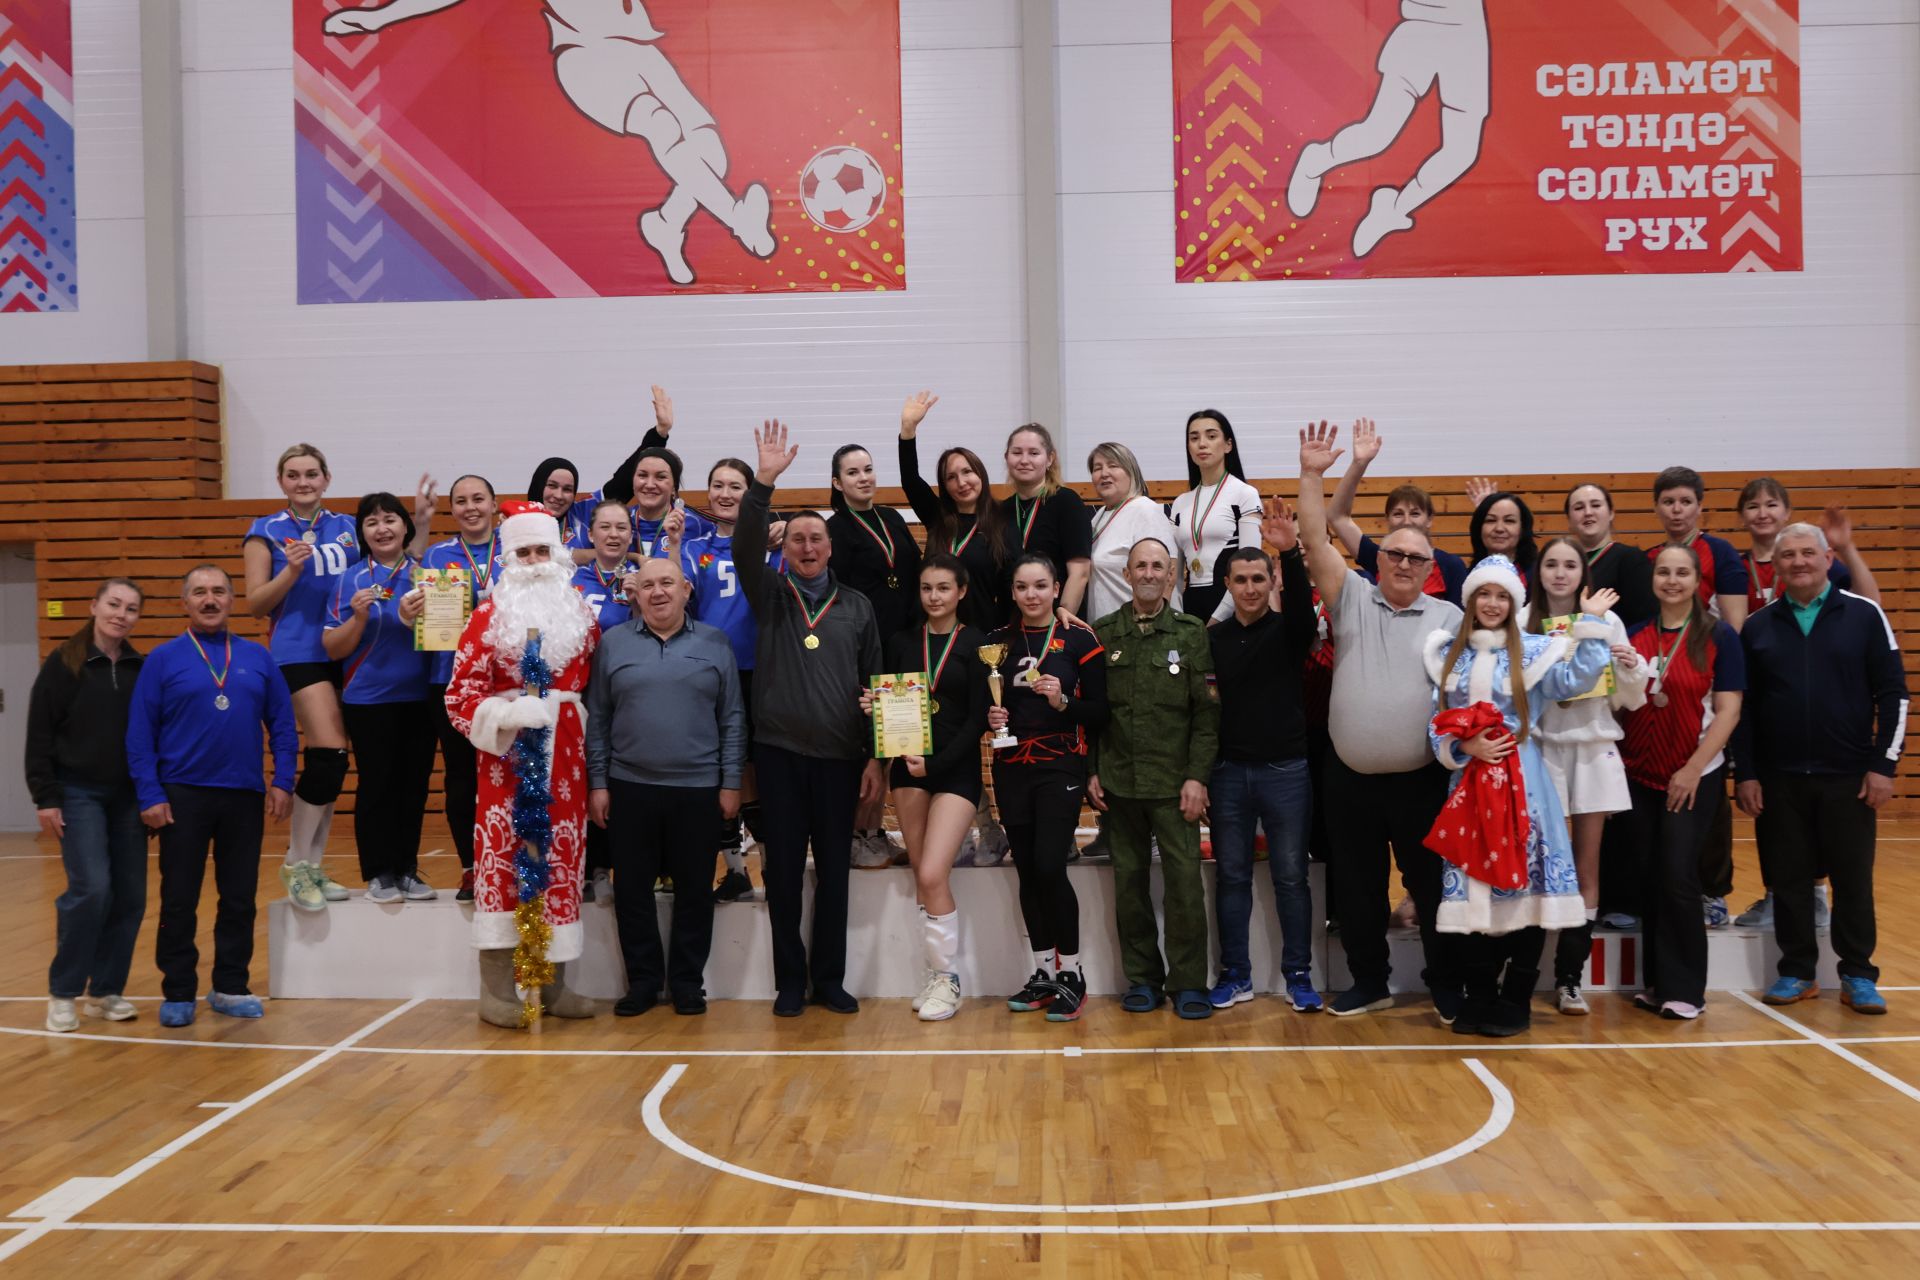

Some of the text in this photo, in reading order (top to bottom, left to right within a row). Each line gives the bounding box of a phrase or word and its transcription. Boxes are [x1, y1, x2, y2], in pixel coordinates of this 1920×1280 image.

[1536, 59, 1772, 97] СӘЛАМӘТ
[1561, 112, 1746, 152] ТӘНДӘ-
[1538, 163, 1774, 201] СӘЛАМӘТ
[1605, 217, 1708, 251] РУХ
[309, 543, 347, 576] 10
[717, 560, 736, 598] 5
[1013, 656, 1038, 687] 2
